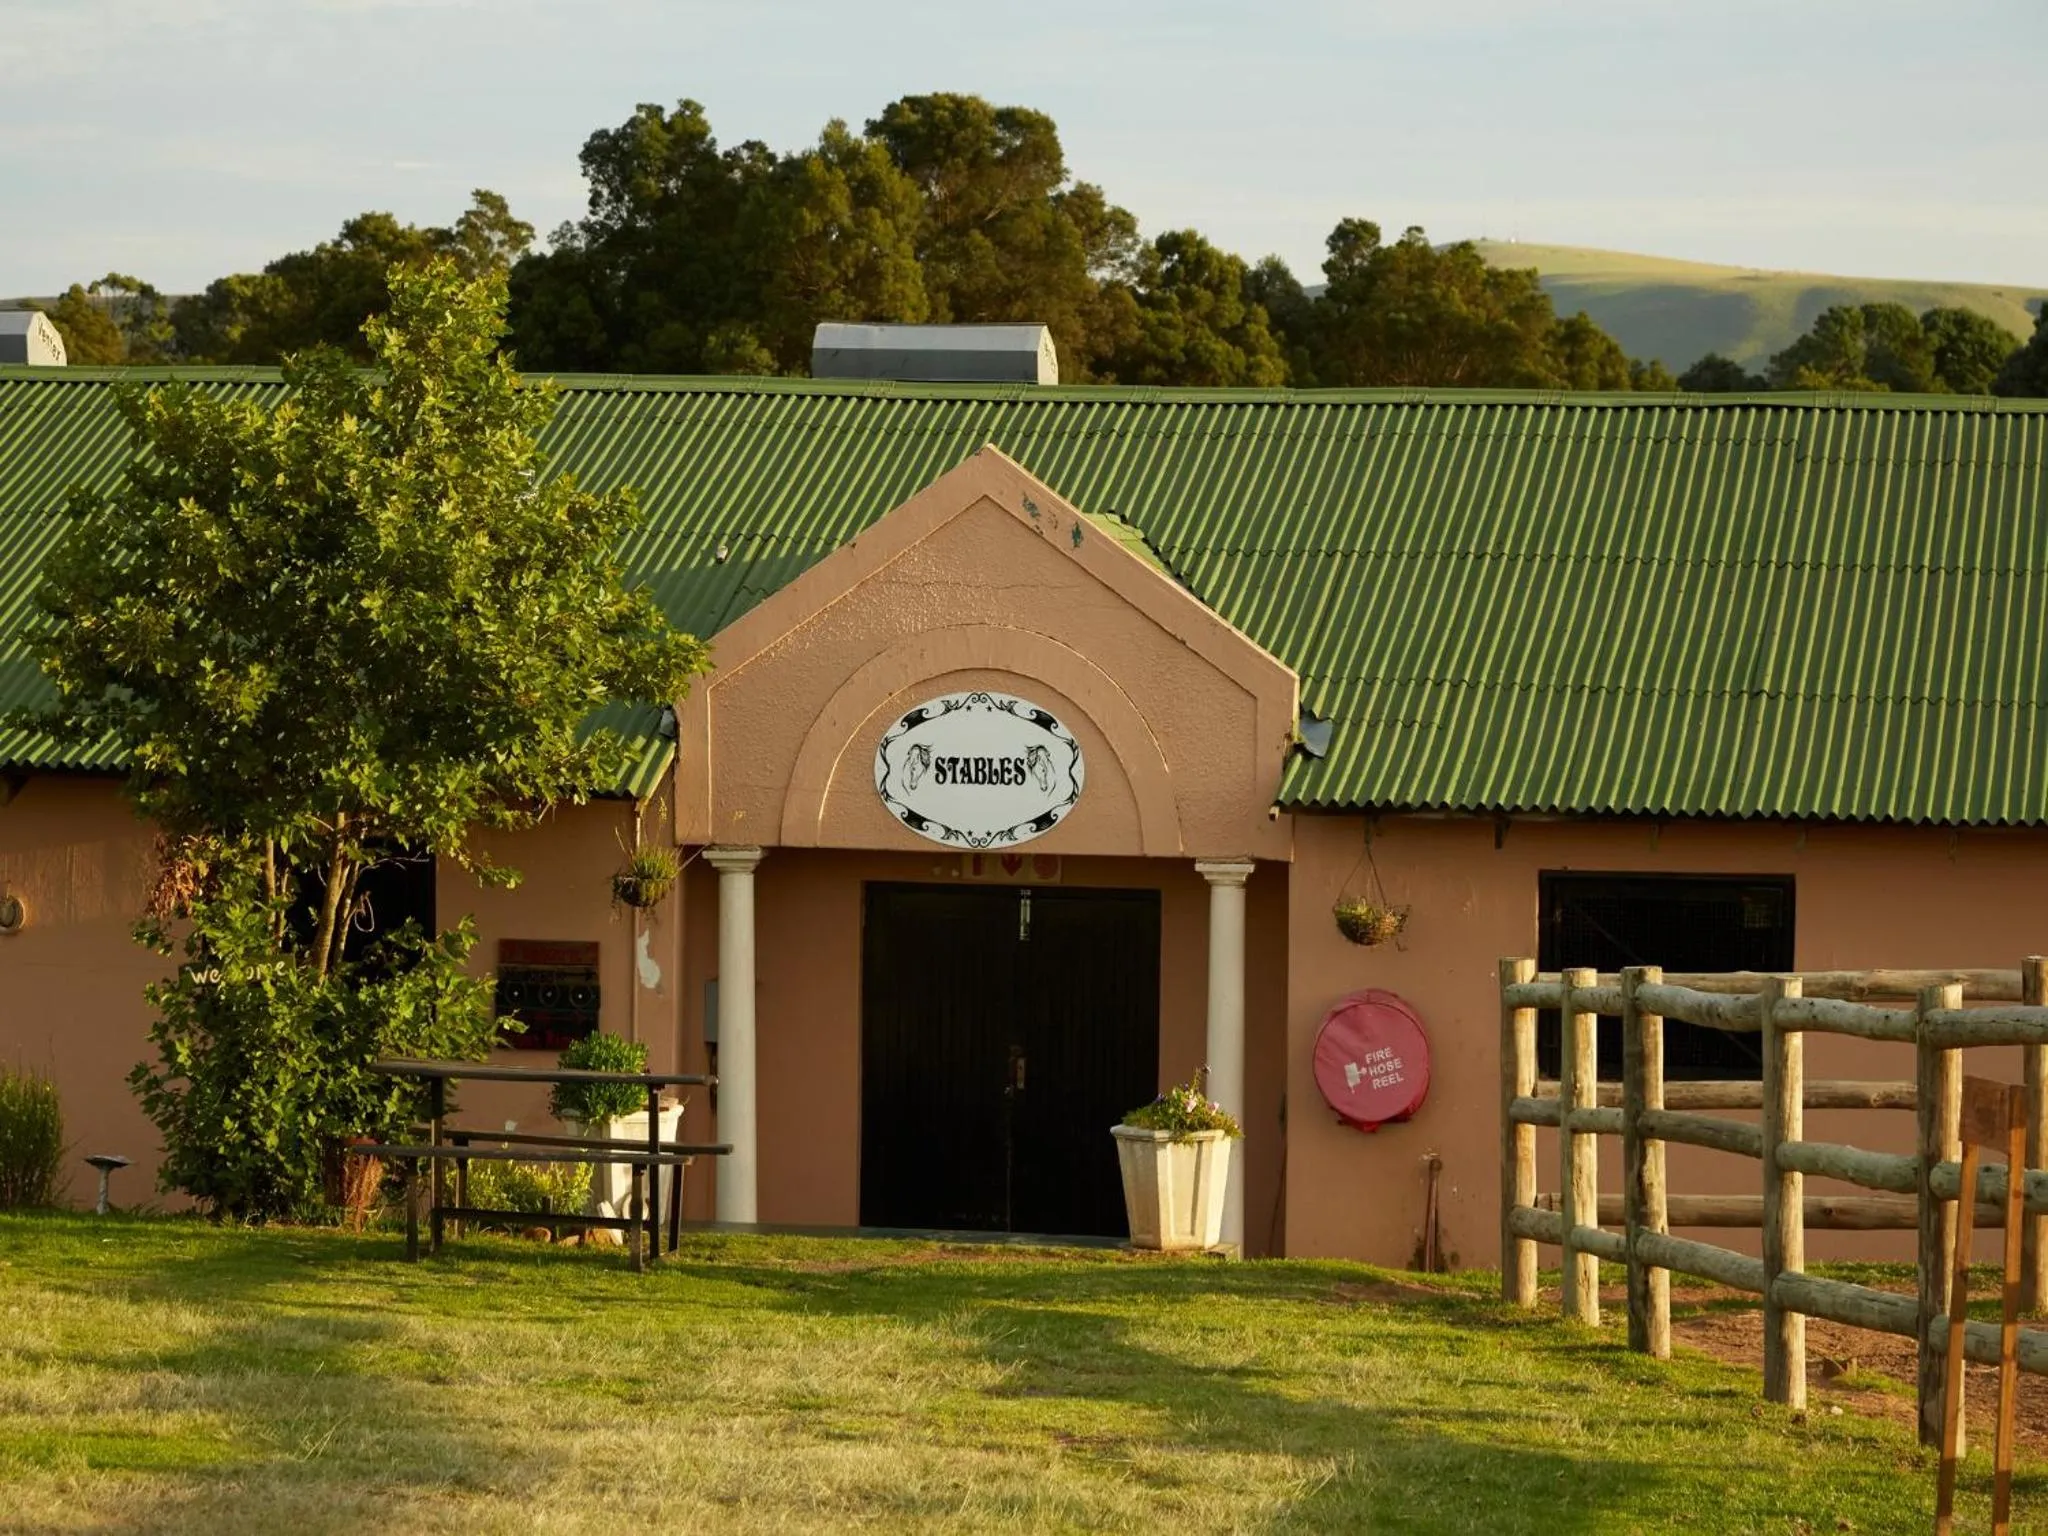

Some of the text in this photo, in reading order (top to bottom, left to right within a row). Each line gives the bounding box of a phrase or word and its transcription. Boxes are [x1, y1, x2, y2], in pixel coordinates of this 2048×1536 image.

[934, 756, 1026, 785] STABLES
[1365, 1047, 1394, 1064] FIRE
[1368, 1058, 1404, 1077] HOSE
[1372, 1072, 1405, 1089] REEL
